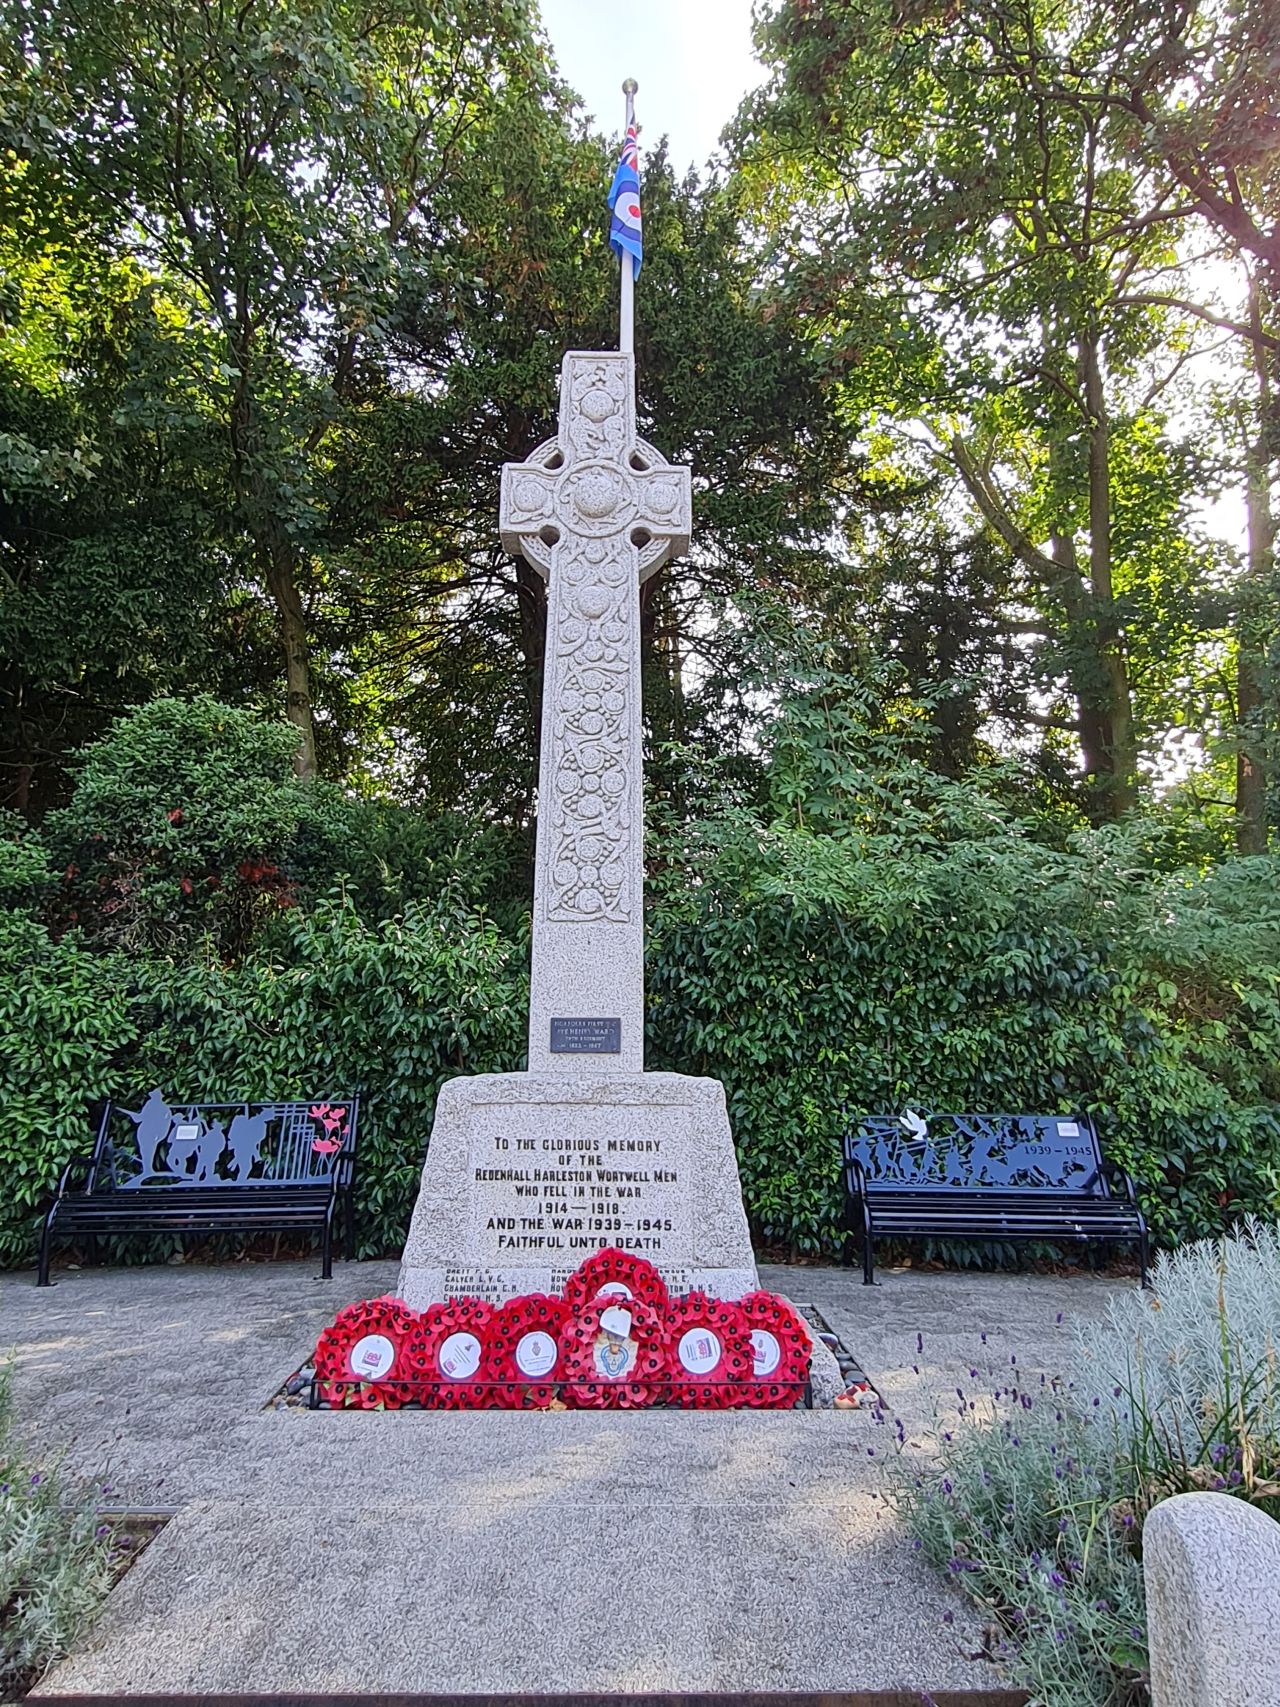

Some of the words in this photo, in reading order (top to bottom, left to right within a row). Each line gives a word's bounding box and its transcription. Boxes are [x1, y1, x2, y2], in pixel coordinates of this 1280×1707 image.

[494, 1137, 509, 1150] TO
[516, 1139, 536, 1150] THE
[542, 1140, 599, 1151] GLORIOUS
[608, 1140, 661, 1151] MEMORY
[1024, 1146, 1052, 1154] 1939
[1065, 1146, 1092, 1156] 1945
[558, 1155, 572, 1165] OF
[580, 1156, 602, 1165] THE
[475, 1169, 530, 1181] REDENHALL
[534, 1170, 592, 1181] HARLESTON
[596, 1170, 650, 1182] WORTWELL
[654, 1170, 677, 1182] MEN
[515, 1186, 538, 1197] WHO
[544, 1186, 567, 1197] FELL
[574, 1187, 585, 1197] IN
[590, 1187, 612, 1197] THE
[616, 1187, 641, 1198] WAR
[538, 1203, 568, 1214] 1914
[486, 1218, 515, 1230] AND
[520, 1218, 544, 1230] THE
[552, 1218, 582, 1230] WAR
[499, 1236, 564, 1248] FAITHFUL
[570, 1237, 607, 1248] UNTO
[616, 1238, 661, 1249] DEATH
